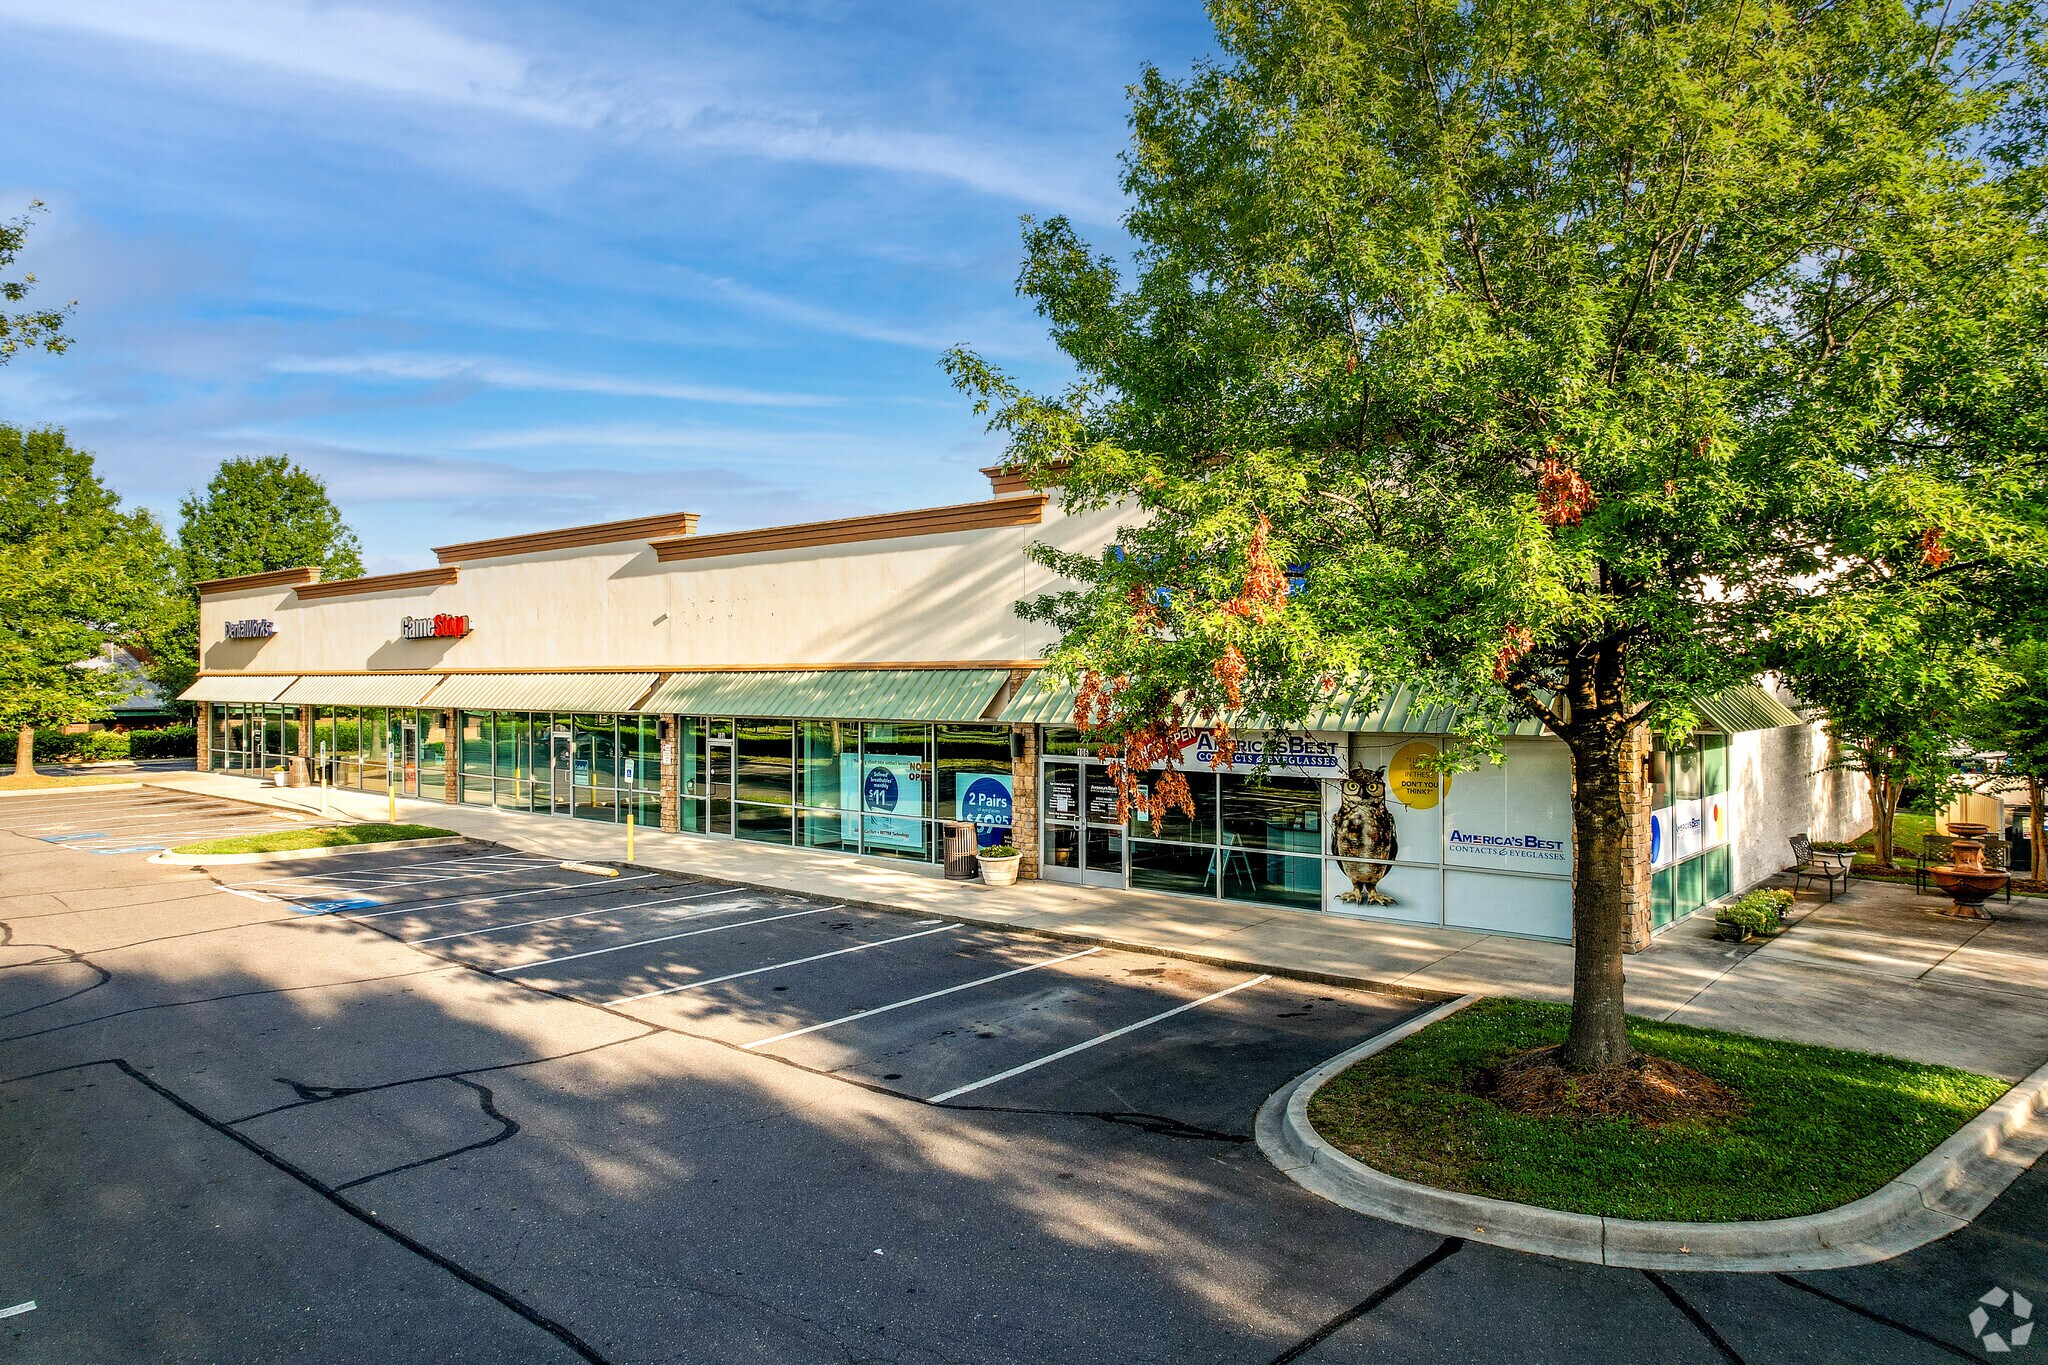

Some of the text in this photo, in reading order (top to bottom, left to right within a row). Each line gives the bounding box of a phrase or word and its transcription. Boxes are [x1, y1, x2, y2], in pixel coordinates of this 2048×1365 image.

[225, 619, 271, 638] DentalWorks
[401, 613, 467, 639] GameStop
[969, 792, 1008, 808] 2 Pairs
[1450, 830, 1564, 850] AMERICA'S BEST
[1449, 845, 1566, 861] CONTACTS & EYEGLASSES
